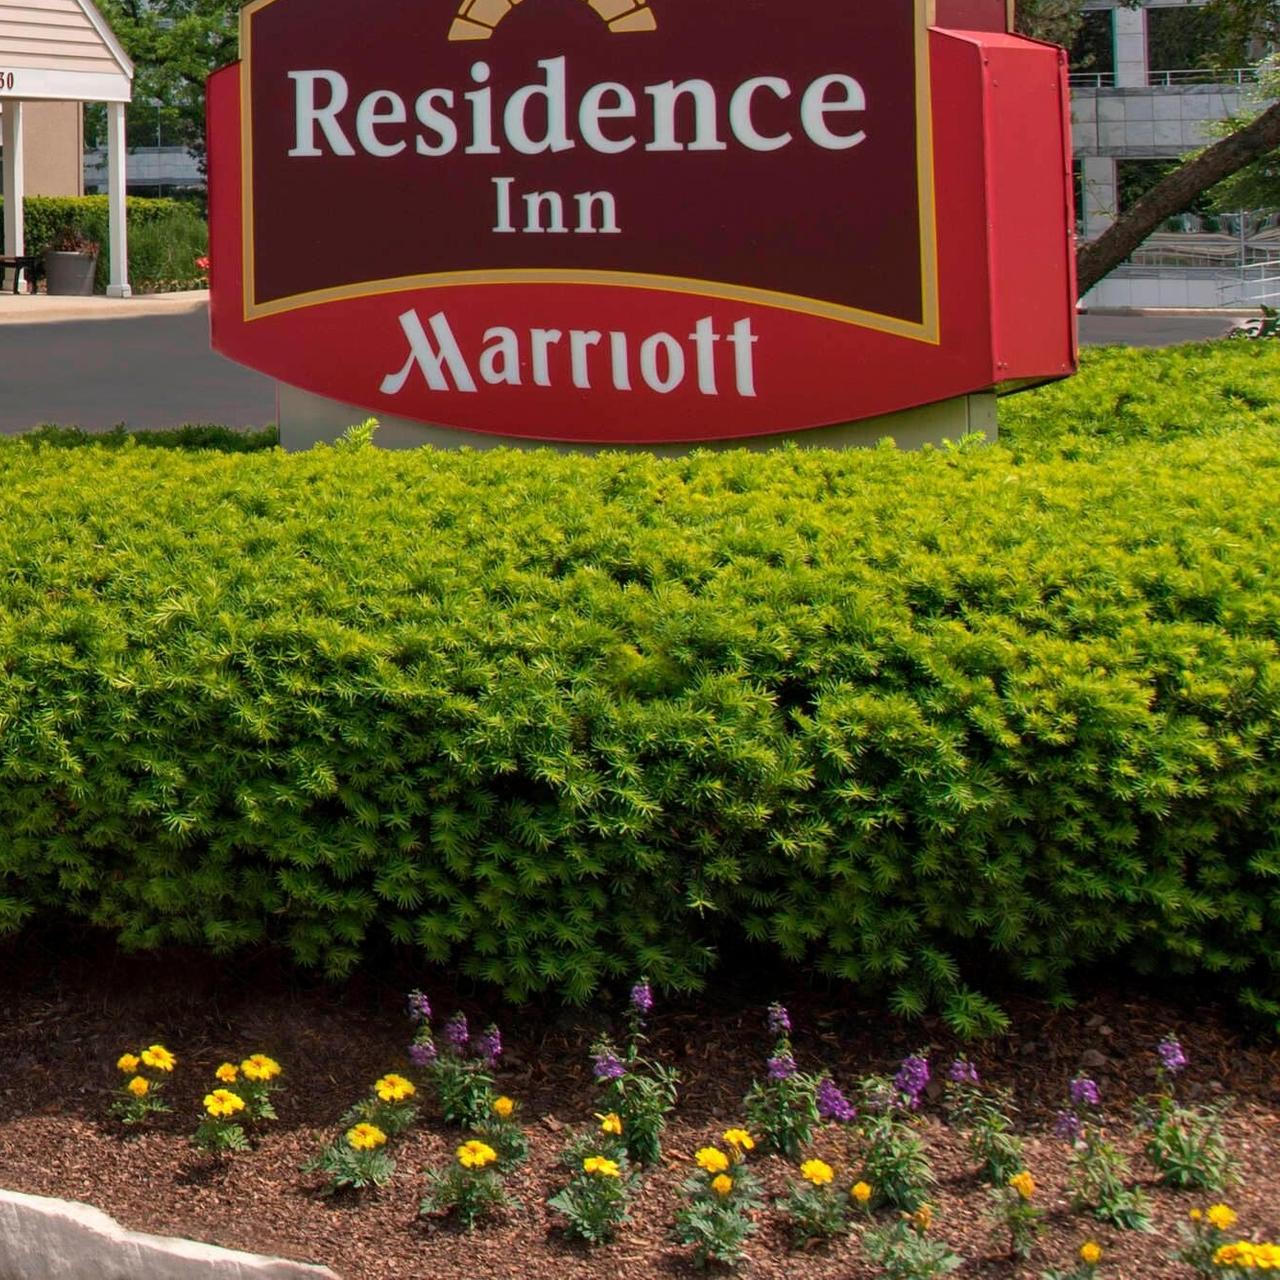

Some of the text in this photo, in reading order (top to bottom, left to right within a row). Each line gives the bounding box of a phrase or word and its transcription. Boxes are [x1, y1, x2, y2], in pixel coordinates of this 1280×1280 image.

[287, 55, 867, 157] Residence
[491, 176, 622, 233] Inn
[379, 308, 759, 397] Marriott
